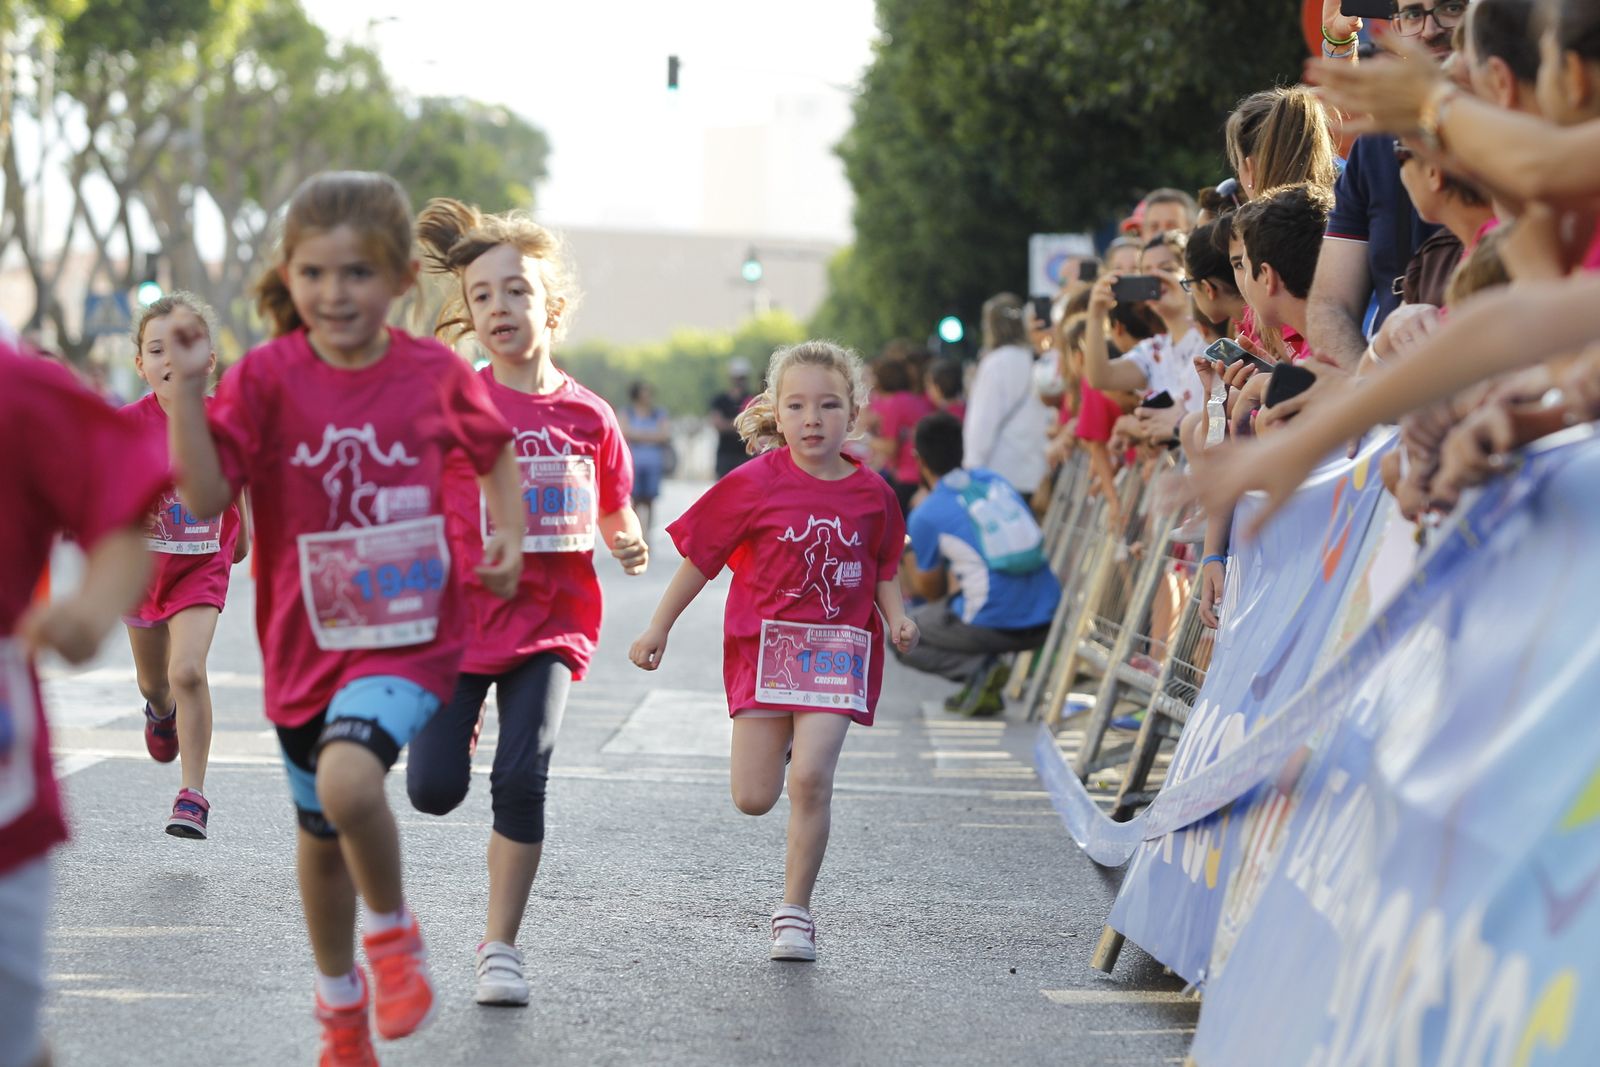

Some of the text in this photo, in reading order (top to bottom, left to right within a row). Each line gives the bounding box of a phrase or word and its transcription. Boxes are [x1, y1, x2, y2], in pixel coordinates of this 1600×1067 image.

[352, 559, 444, 602] 1949
[832, 561, 843, 586] 4
[811, 629, 840, 638] CARRERA
[796, 650, 864, 679] 1592
[814, 676, 848, 685] CRISTINA
